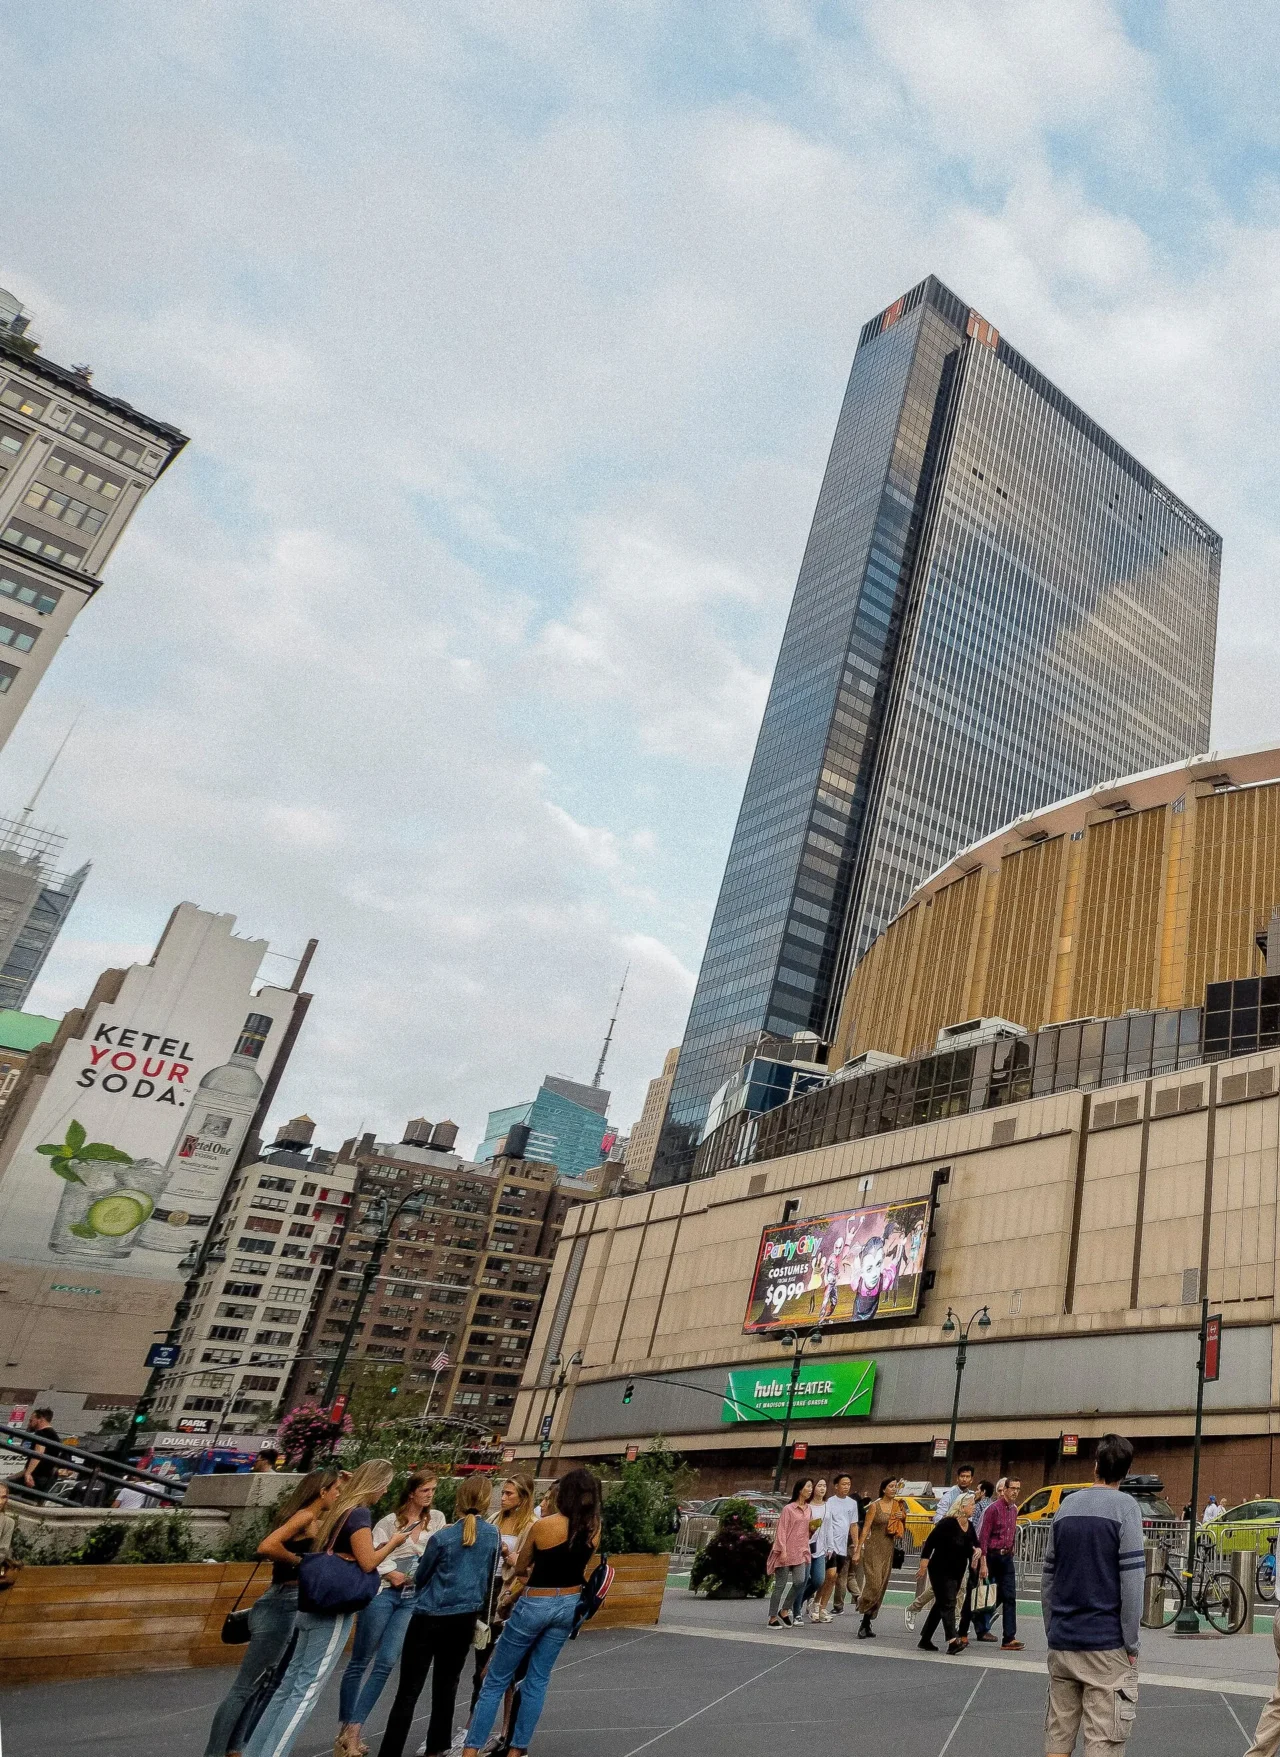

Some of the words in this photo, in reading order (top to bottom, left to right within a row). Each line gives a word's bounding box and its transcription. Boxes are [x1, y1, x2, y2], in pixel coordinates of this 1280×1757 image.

[93, 1022, 195, 1062] KETEL
[89, 1044, 190, 1084] YOUR
[763, 1239, 797, 1261] Party
[796, 1235, 823, 1257] City
[768, 1263, 809, 1278] COSTUMES
[754, 1380, 783, 1398] hulu
[180, 1419, 208, 1428] PARK
[162, 1437, 200, 1447] DUANE
